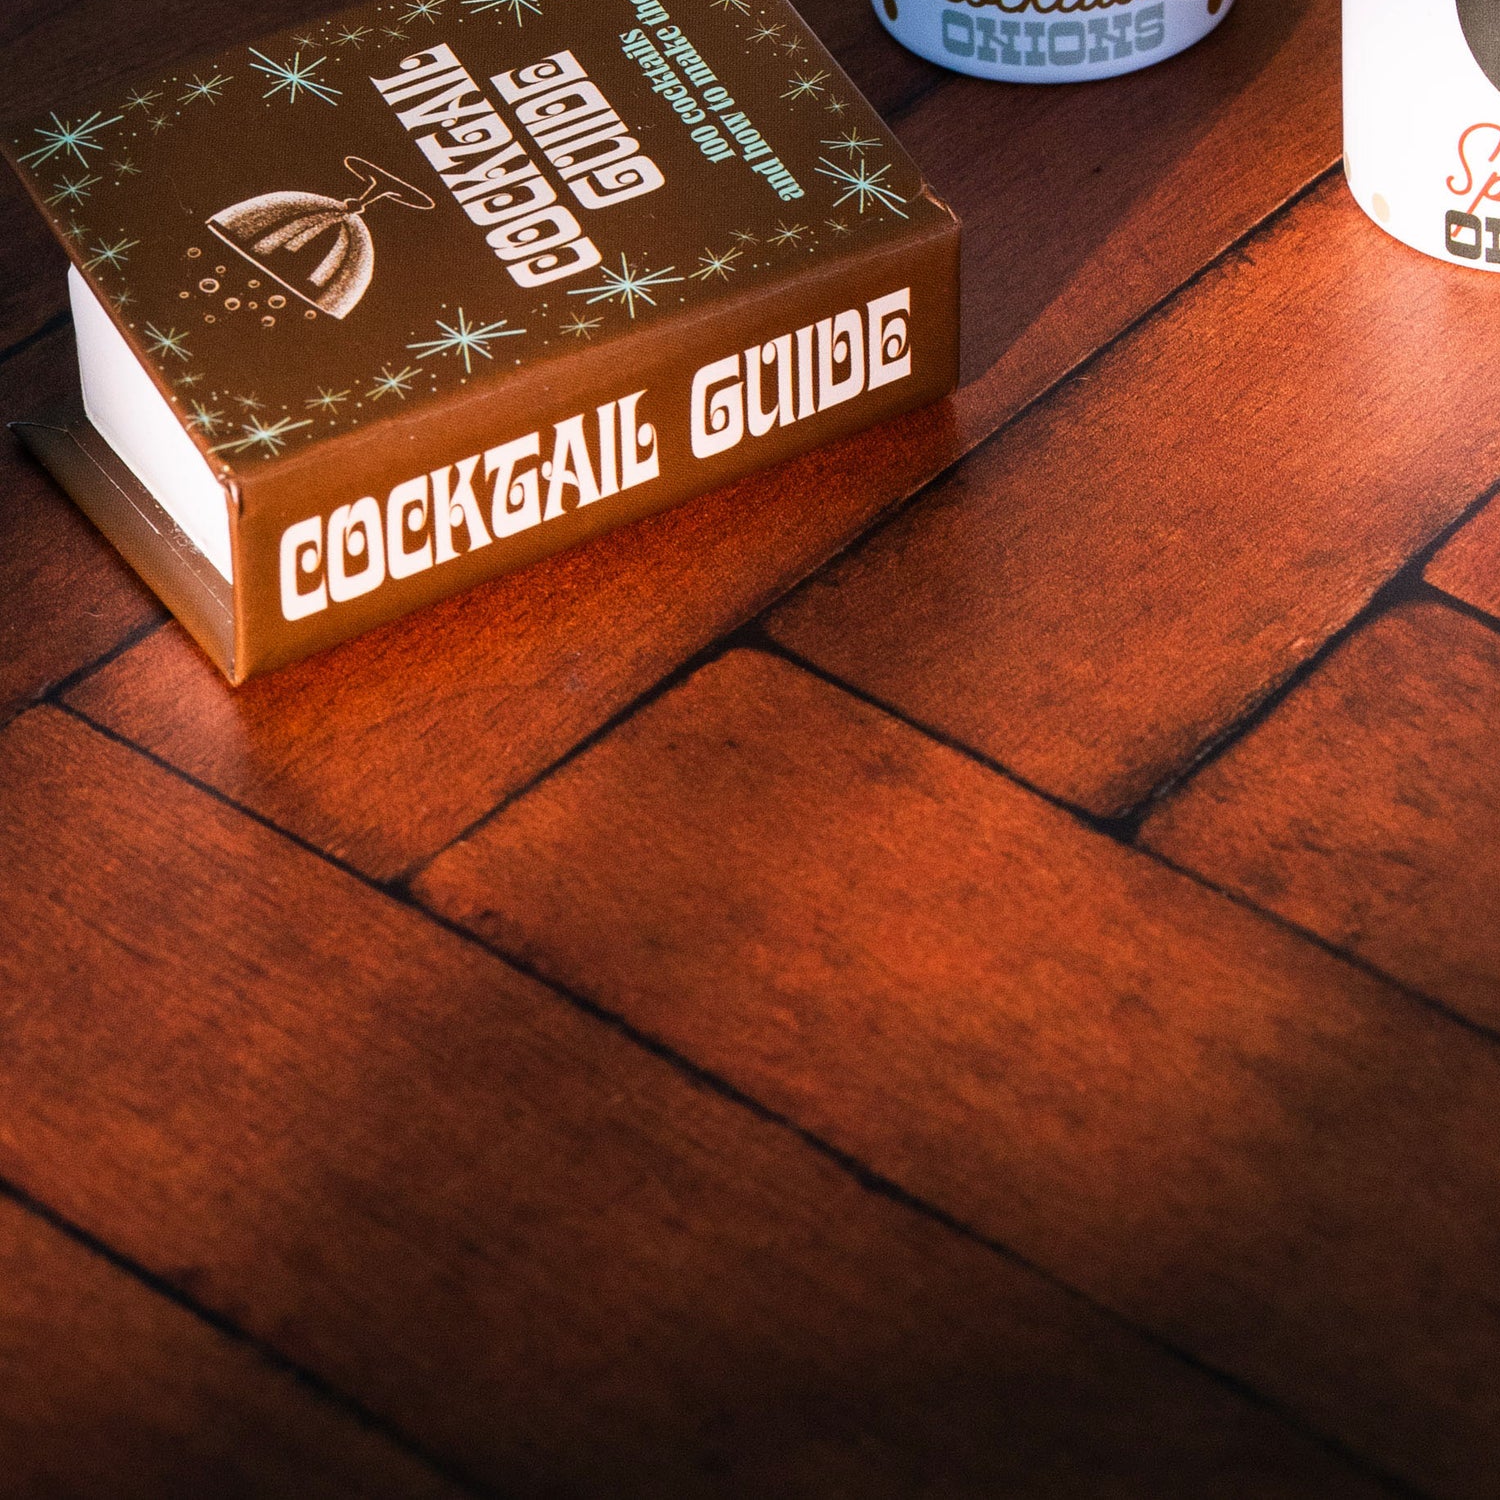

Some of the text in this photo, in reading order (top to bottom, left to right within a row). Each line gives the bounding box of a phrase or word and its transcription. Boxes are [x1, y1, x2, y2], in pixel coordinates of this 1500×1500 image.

[656, 25, 720, 89] make
[941, 0, 1166, 67] ONIONS
[619, 27, 737, 164] 100 cocktails
[703, 83, 738, 113] to
[489, 50, 666, 210] GUIDE
[720, 111, 774, 163] how
[369, 42, 603, 289] COCKTAIL
[752, 156, 806, 203] and
[279, 286, 912, 622] COCKTAIL GUIDE
